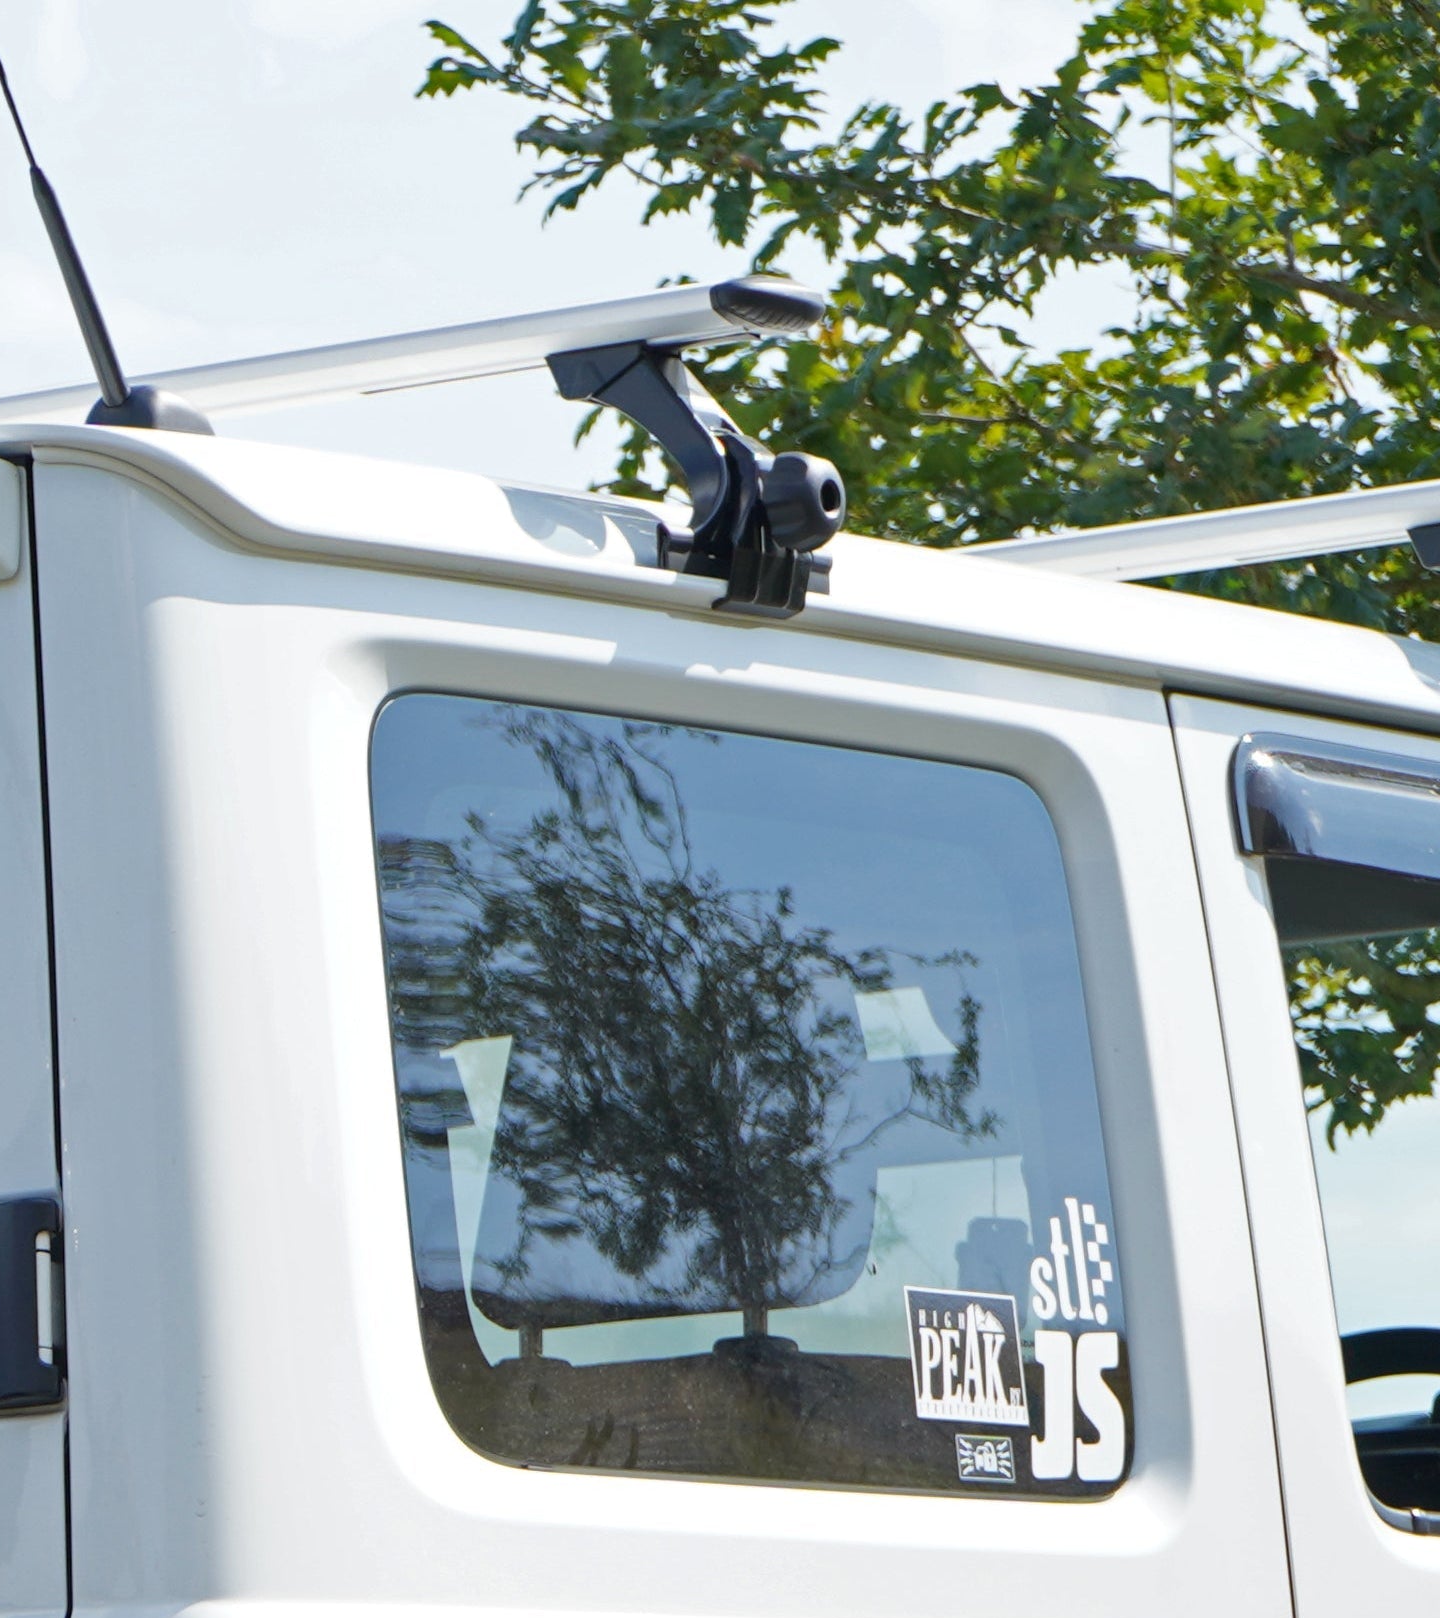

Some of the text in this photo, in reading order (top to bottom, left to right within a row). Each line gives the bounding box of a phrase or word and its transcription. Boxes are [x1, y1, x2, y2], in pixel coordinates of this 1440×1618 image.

[918, 1308, 966, 1330] HIGH
[918, 1302, 1011, 1407] PEAK
[1030, 1330, 1126, 1482] JS
